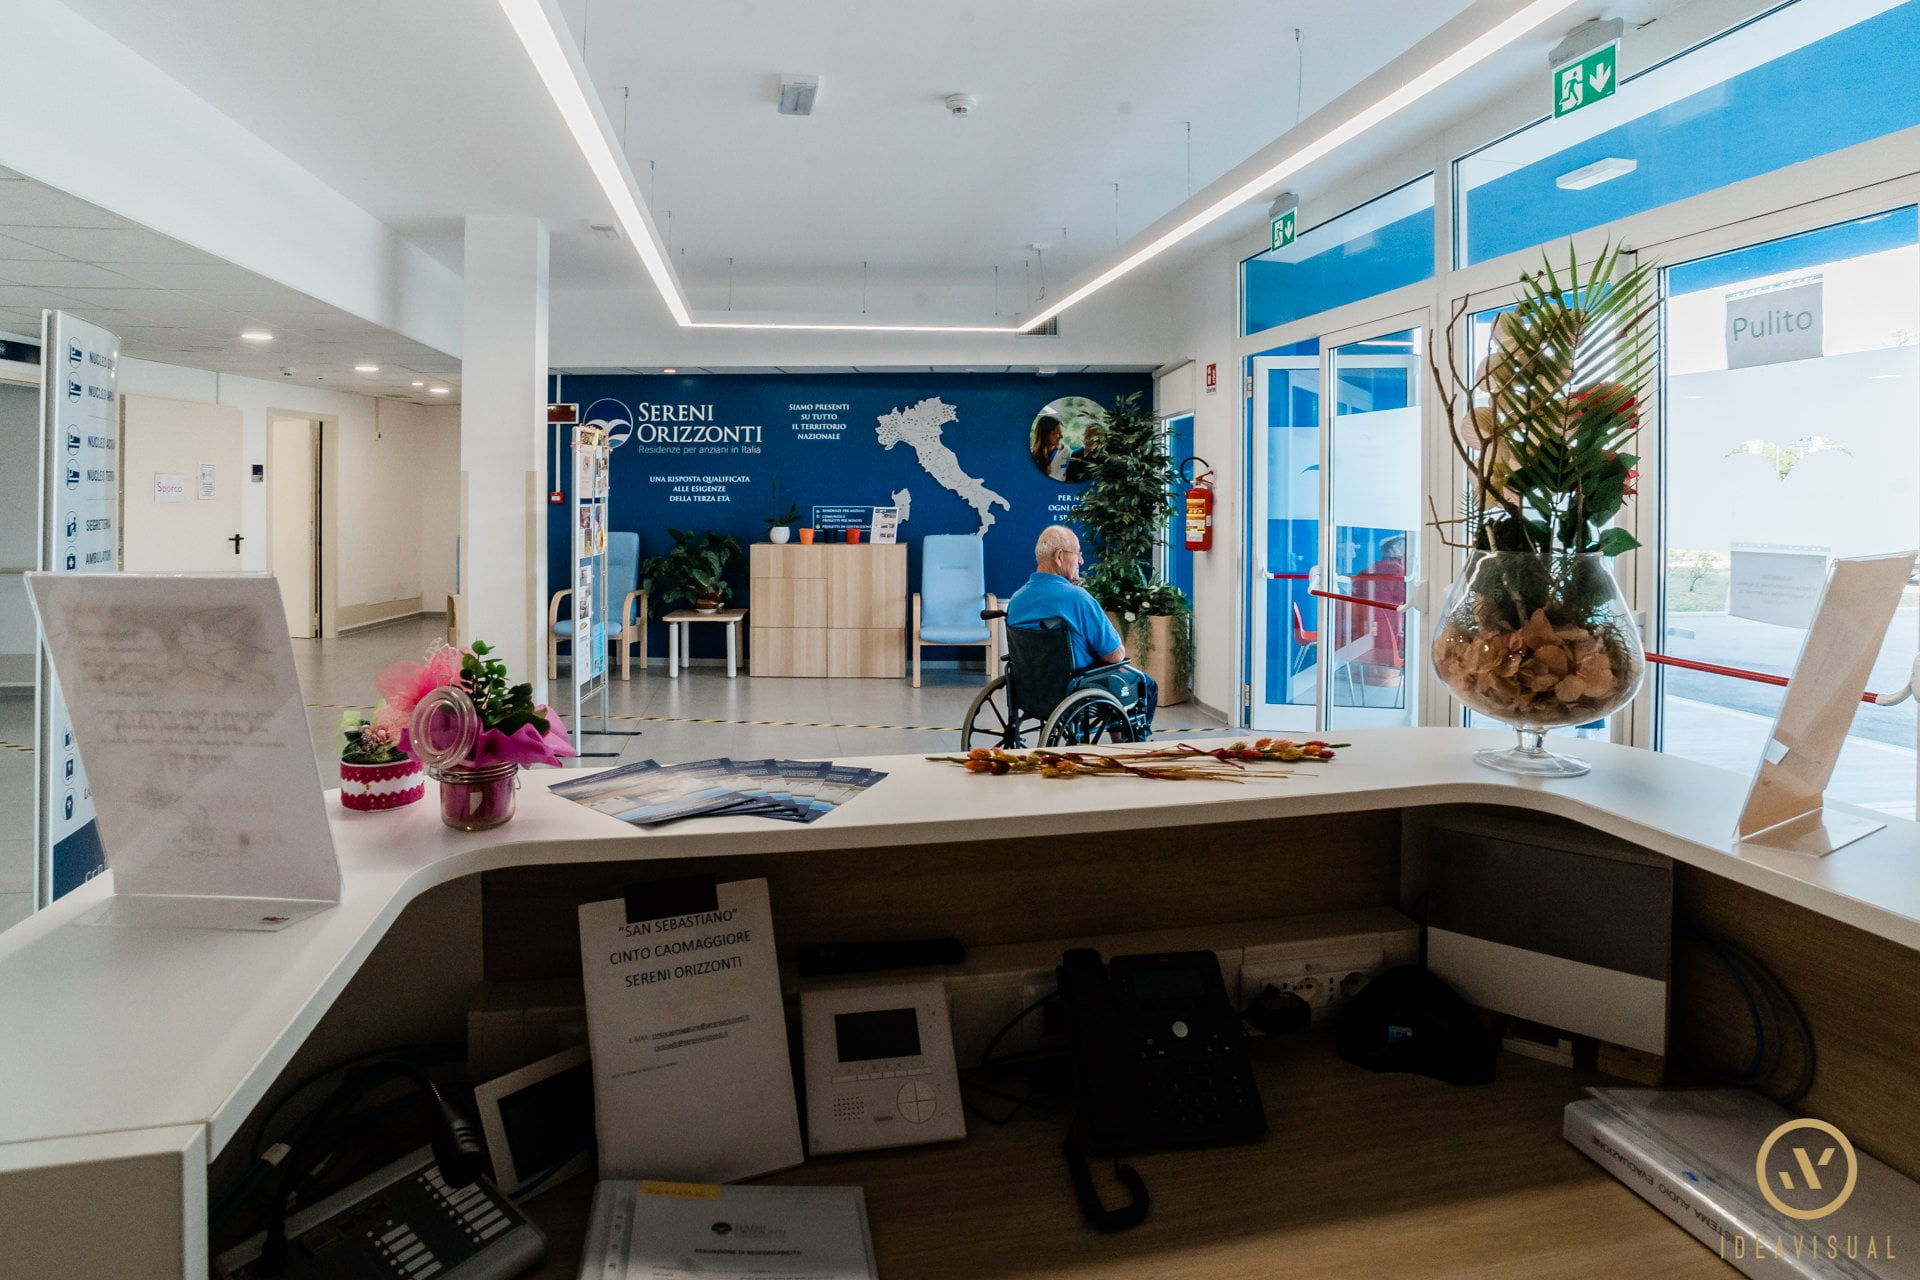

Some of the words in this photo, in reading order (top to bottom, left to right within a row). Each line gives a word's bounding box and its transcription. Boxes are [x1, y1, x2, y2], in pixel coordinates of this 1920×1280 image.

[1732, 309, 1814, 342] Pulito
[638, 402, 714, 422] SERENI
[789, 403, 814, 411] SIAMO
[815, 403, 850, 411] PRESENTI
[800, 413, 811, 421] SU
[812, 413, 838, 421] TUTTO
[637, 423, 763, 443] ORIZZONTI
[638, 445, 681, 454] Residenze
[683, 447, 697, 457] per
[699, 445, 728, 454] anziani
[730, 445, 739, 454] in
[741, 445, 761, 454] Italia
[702, 476, 750, 484] QUALIFICATA
[157, 481, 183, 494] Sporco
[717, 493, 731, 502] ETÀ
[609, 946, 651, 965] CINTO
[654, 930, 752, 957] CAOMAGGIORE
[625, 968, 671, 988] SERENI
[674, 956, 742, 979] ORIZZONTI
